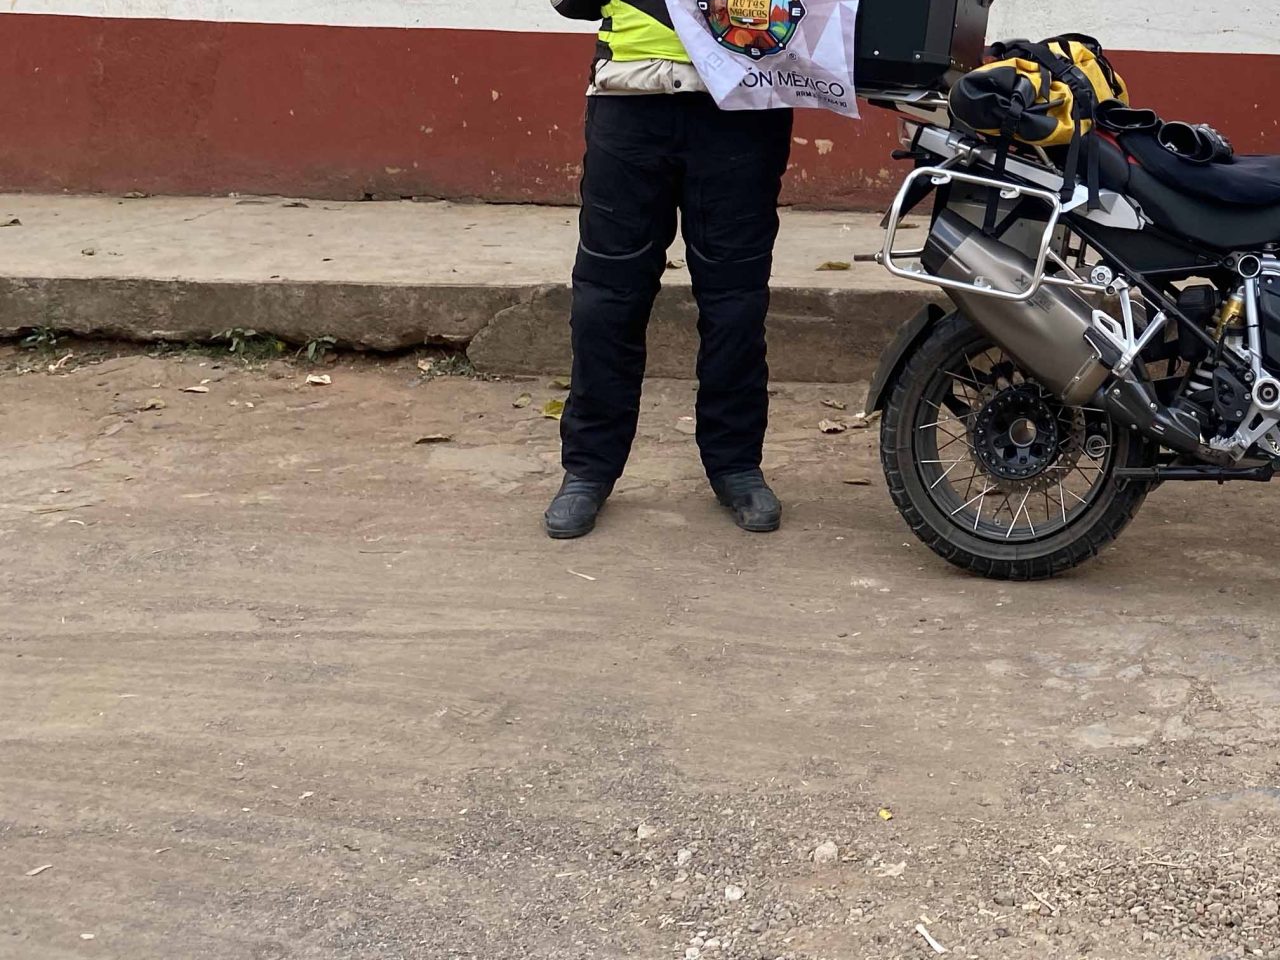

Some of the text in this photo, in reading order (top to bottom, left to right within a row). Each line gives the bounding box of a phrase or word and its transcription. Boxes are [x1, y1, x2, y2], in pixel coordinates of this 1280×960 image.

[792, 7, 801, 16] E
[751, 47, 761, 56] S
[777, 71, 845, 97] MÉXICO
